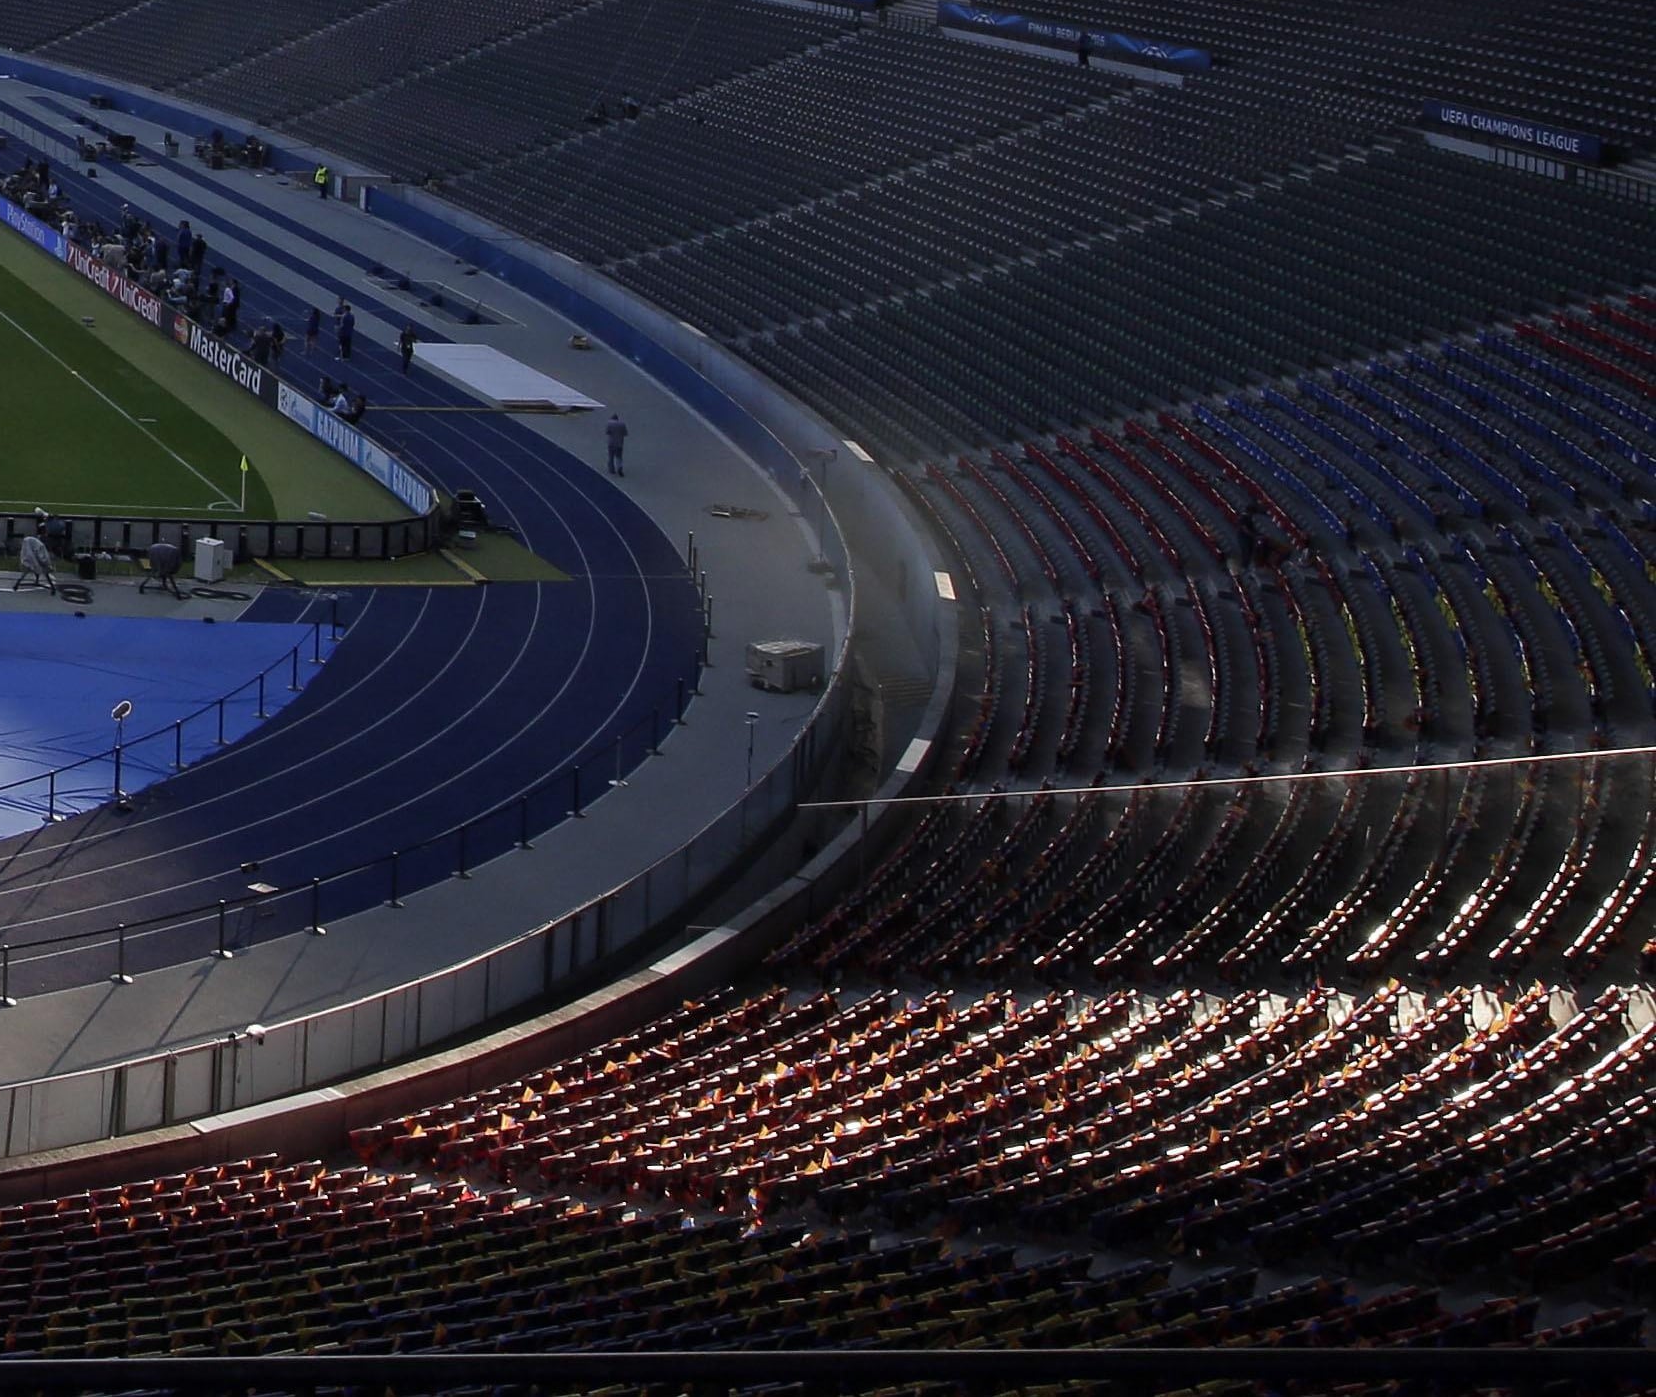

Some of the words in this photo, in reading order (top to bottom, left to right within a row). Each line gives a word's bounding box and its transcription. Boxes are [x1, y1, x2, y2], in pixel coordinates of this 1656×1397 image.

[1440, 107, 1469, 127] UEFA
[1471, 114, 1534, 142] CHAMPIONS
[1536, 130, 1580, 154] LEAGUE
[74, 245, 109, 291] UniCredit
[119, 277, 159, 327] UniCredit
[190, 325, 261, 395] MasterCard
[317, 409, 359, 463] GAZPROM
[392, 463, 430, 514] GAZPROM
